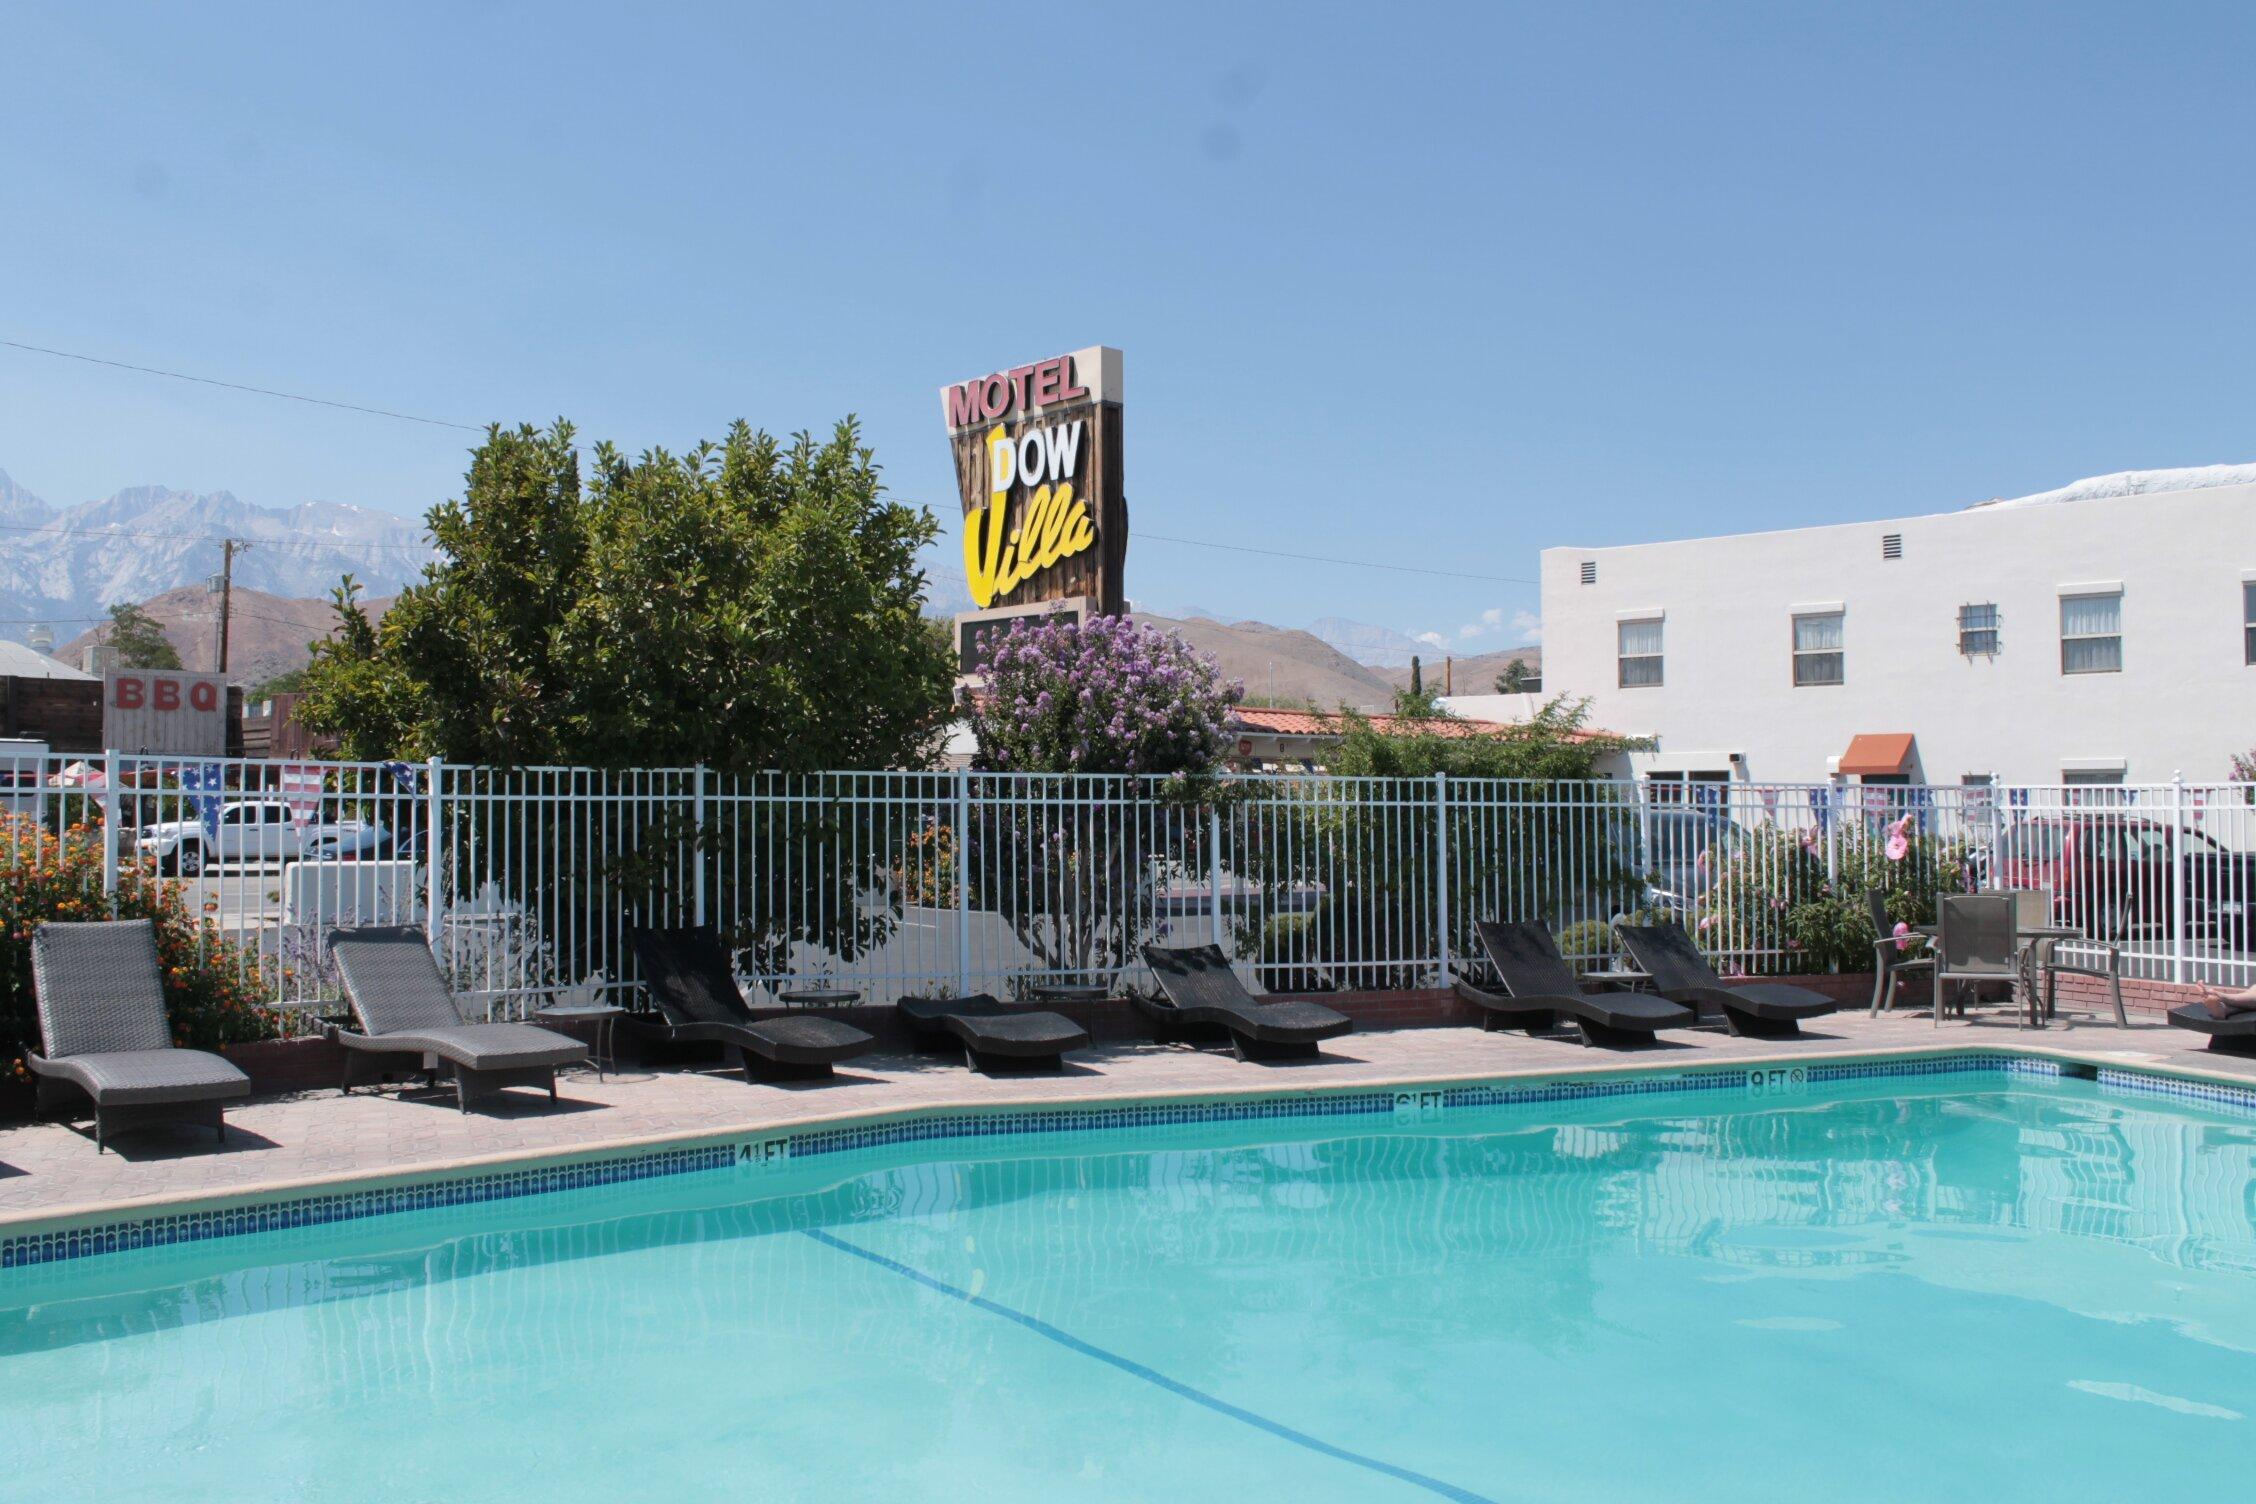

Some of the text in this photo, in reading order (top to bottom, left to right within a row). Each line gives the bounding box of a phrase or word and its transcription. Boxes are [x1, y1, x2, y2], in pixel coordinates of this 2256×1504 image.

[949, 355, 1088, 427] MOTEL
[993, 420, 1084, 492] DOW
[963, 422, 1095, 609] Villa
[116, 677, 218, 712] BBQ
[1768, 1069, 1787, 1086] FT
[1420, 1091, 1442, 1109] FT
[764, 1139, 788, 1161] FT
